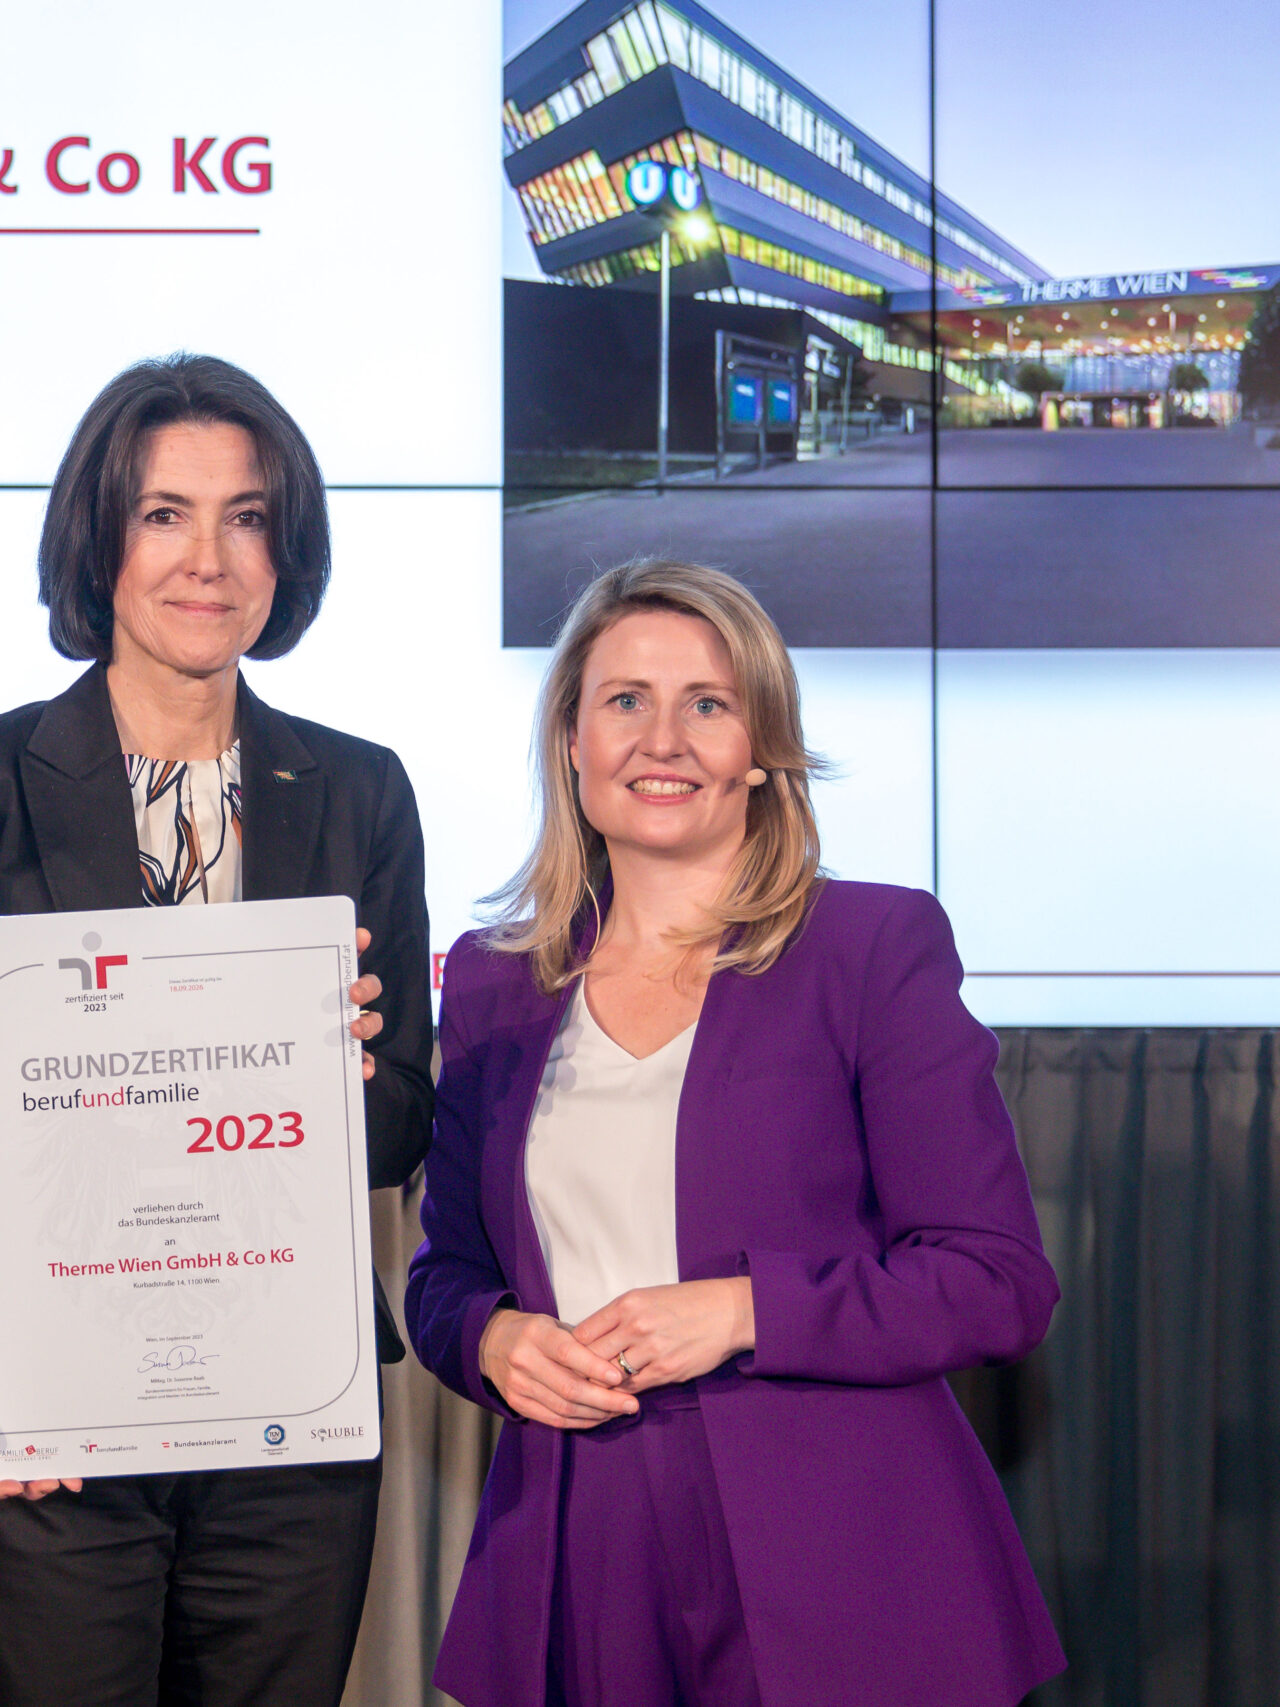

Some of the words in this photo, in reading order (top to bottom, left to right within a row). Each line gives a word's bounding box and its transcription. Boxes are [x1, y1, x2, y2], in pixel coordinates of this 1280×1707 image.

[45, 136, 141, 194] Co
[173, 136, 272, 194] KG
[1022, 277, 1110, 301] THERME
[1115, 271, 1188, 296] WIEN
[65, 993, 107, 1004] zertifiziert
[109, 992, 124, 1001] seit
[83, 1003, 107, 1013] 2023
[20, 1041, 296, 1082] GRUNDZERTIFIKAT
[22, 1082, 200, 1112] berufundfamilie
[186, 1111, 305, 1154] 2023
[133, 1203, 175, 1214] verliehen
[177, 1201, 204, 1211] durch
[118, 1218, 134, 1227] das
[136, 1213, 220, 1227] Bundeskanzleramt
[164, 1238, 176, 1246] an
[47, 1262, 115, 1278] Therme
[118, 1257, 162, 1273] Wien
[166, 1252, 222, 1271] GmbH
[226, 1251, 240, 1267] &
[243, 1249, 267, 1265] Co
[270, 1248, 295, 1264] KG
[204, 1277, 220, 1285] Wien
[174, 1438, 237, 1448] Bundeskanzleramt
